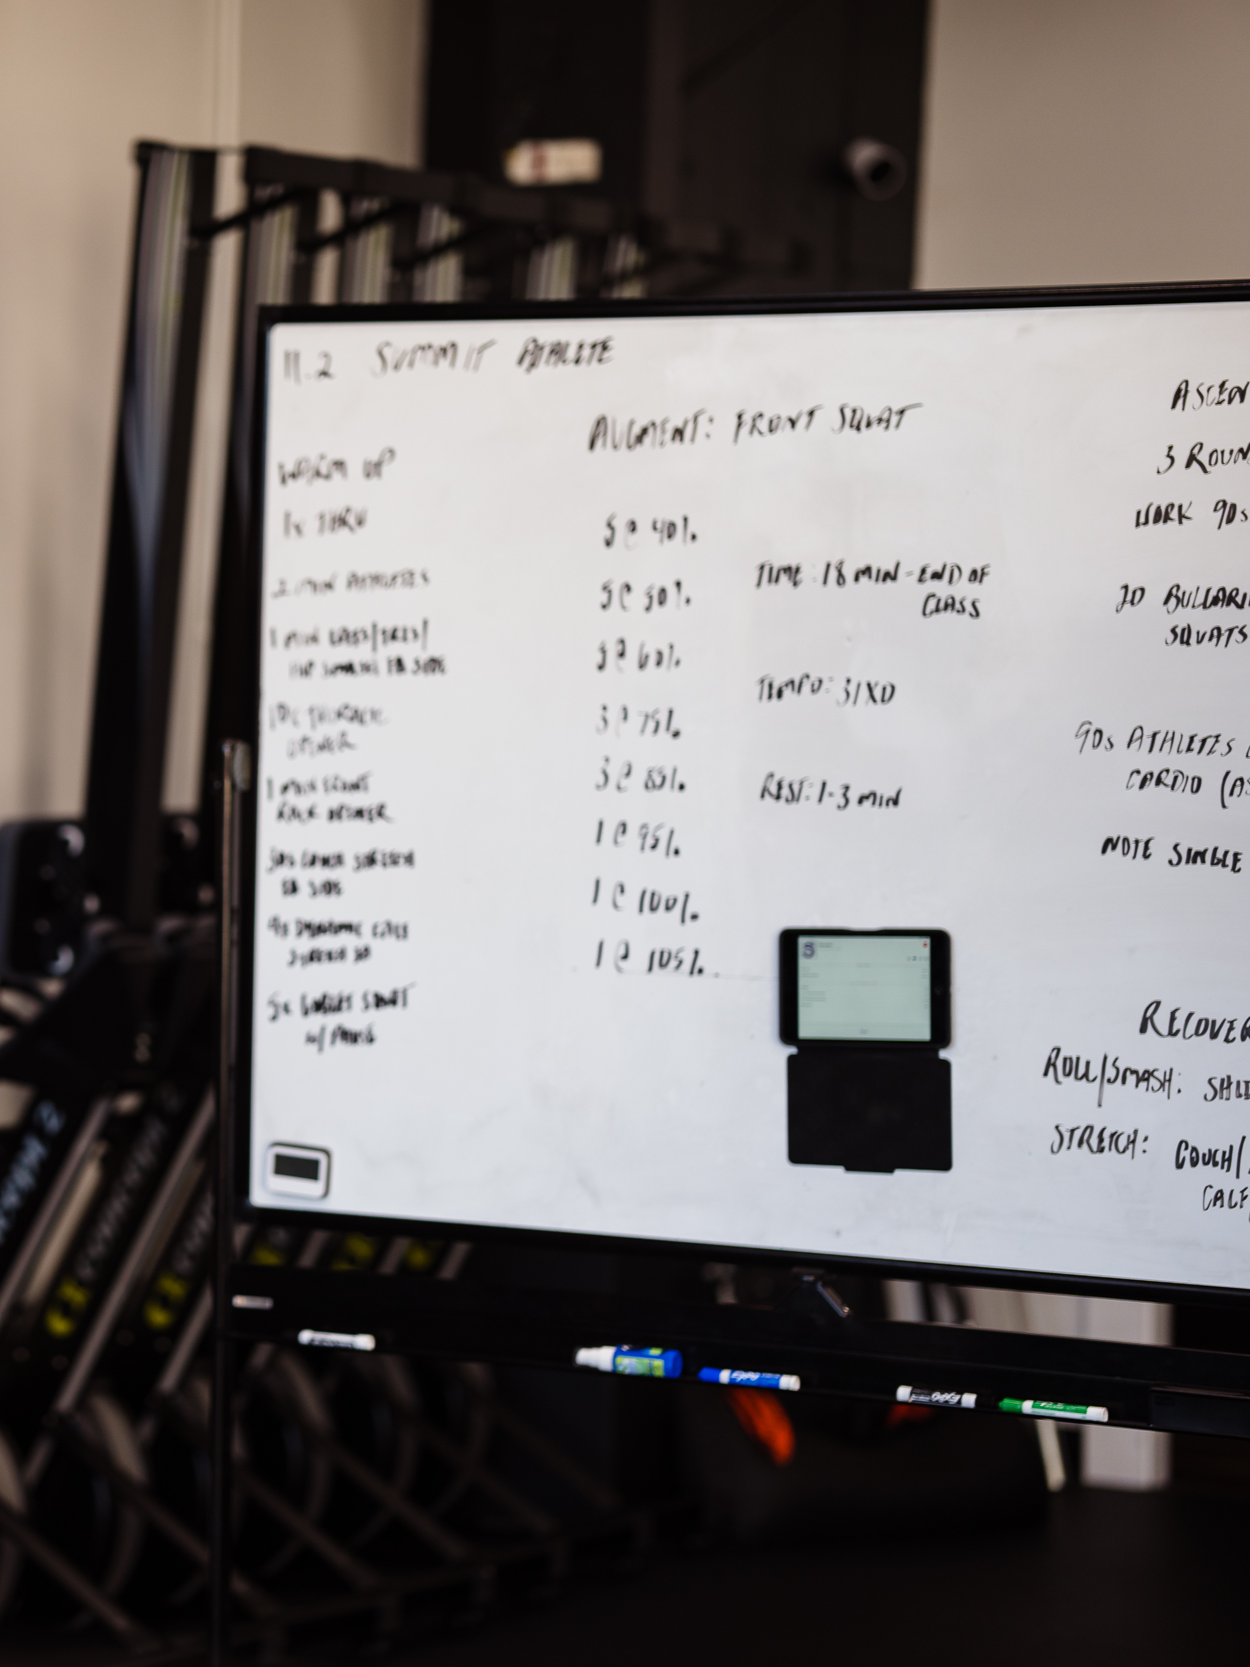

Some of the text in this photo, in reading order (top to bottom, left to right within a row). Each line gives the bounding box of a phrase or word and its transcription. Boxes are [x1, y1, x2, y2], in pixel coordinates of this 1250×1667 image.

[374, 338, 497, 375] SUMMIT
[1170, 378, 1250, 412] ASCEN
[587, 402, 926, 453] AUGMENT: FRONT SQUAT
[361, 446, 397, 481] UP
[1156, 443, 1176, 476] 3
[317, 505, 367, 535] THRU
[821, 559, 847, 589] 18
[853, 560, 901, 585] MIN
[916, 562, 963, 586] END
[967, 563, 991, 585] OF
[921, 591, 981, 620] CLASS
[1164, 622, 1249, 649] SQUATS
[595, 703, 610, 734] 3
[1126, 724, 1236, 758] ATHLETES
[594, 755, 611, 792] 3
[759, 771, 814, 805] REST:
[856, 787, 903, 809] MIN
[1125, 767, 1203, 795] CARDIO
[1100, 834, 1243, 875] NOTE SINGLE
[1050, 1123, 1149, 1161] STRETCH:
[1202, 1184, 1249, 1212] CALF
